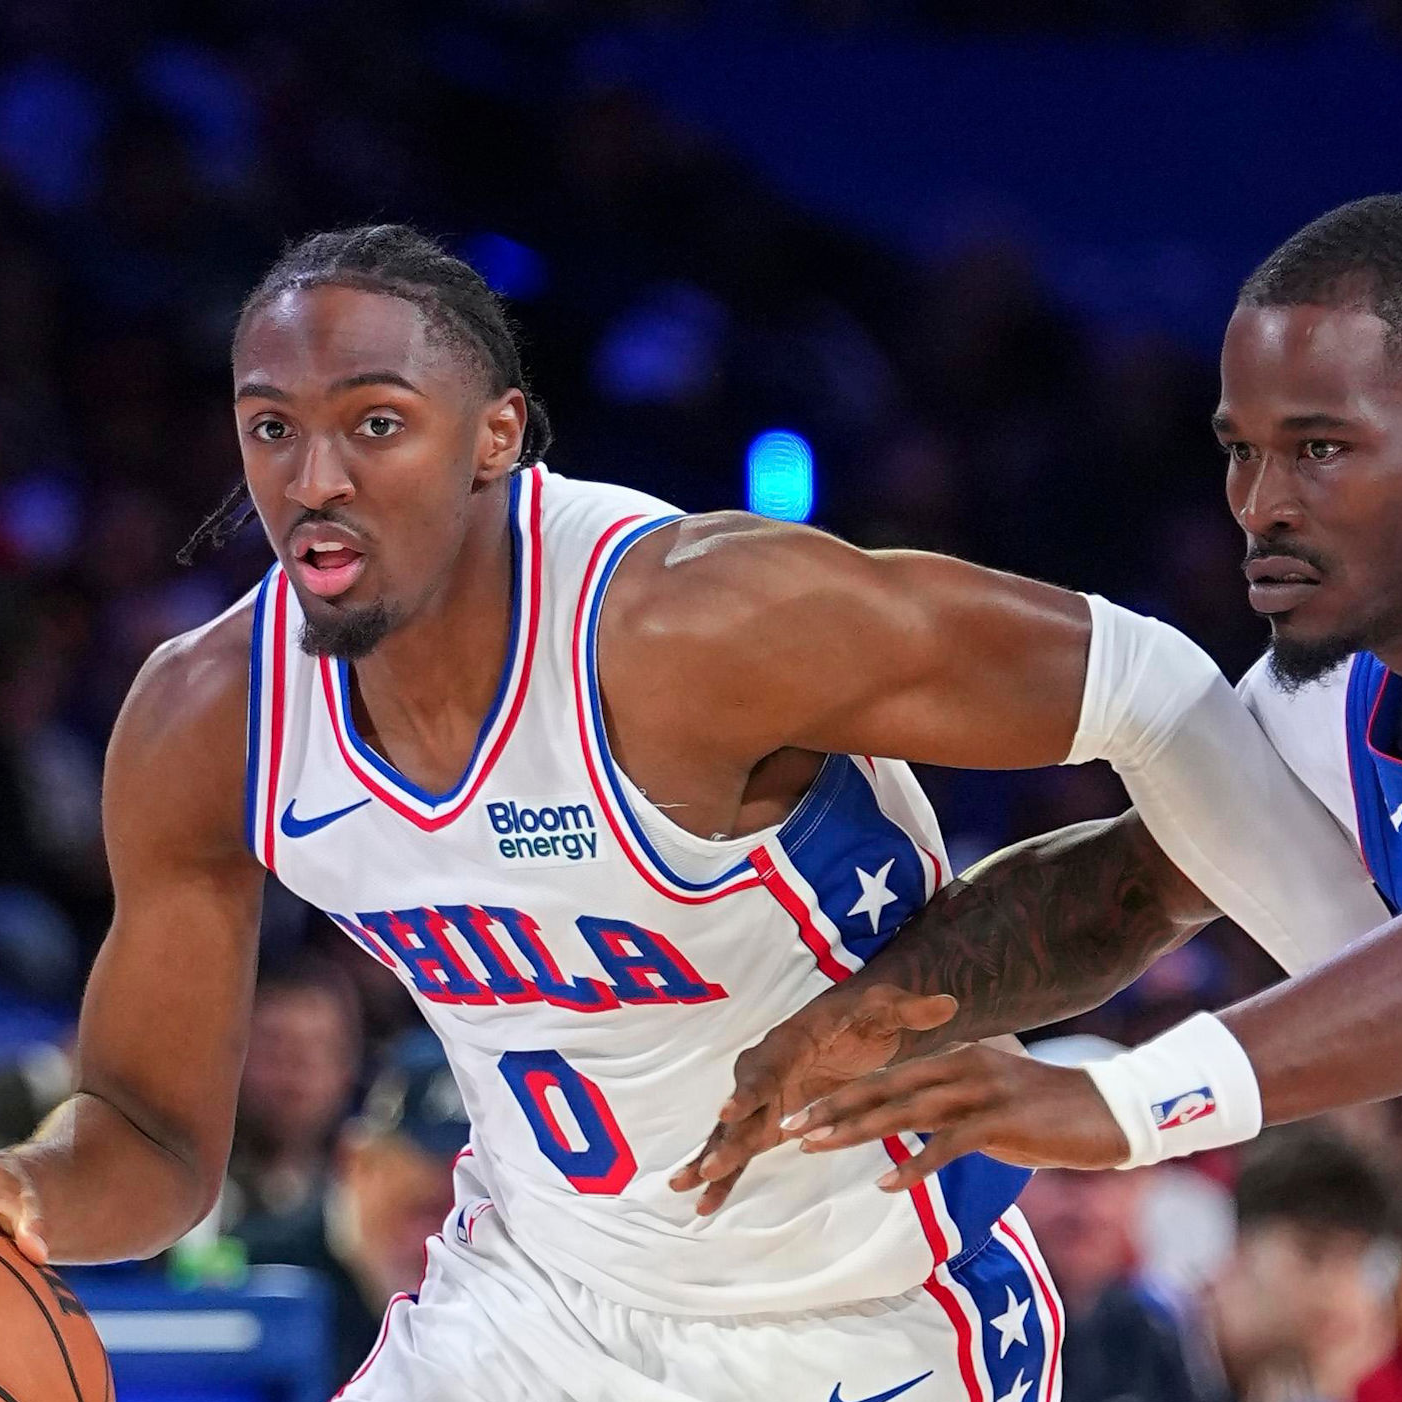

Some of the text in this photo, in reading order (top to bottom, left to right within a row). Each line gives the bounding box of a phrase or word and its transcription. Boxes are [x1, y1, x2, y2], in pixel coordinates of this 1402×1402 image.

[486, 800, 596, 835] Bloom
[498, 832, 597, 860] energy
[497, 1049, 638, 1196] 0
